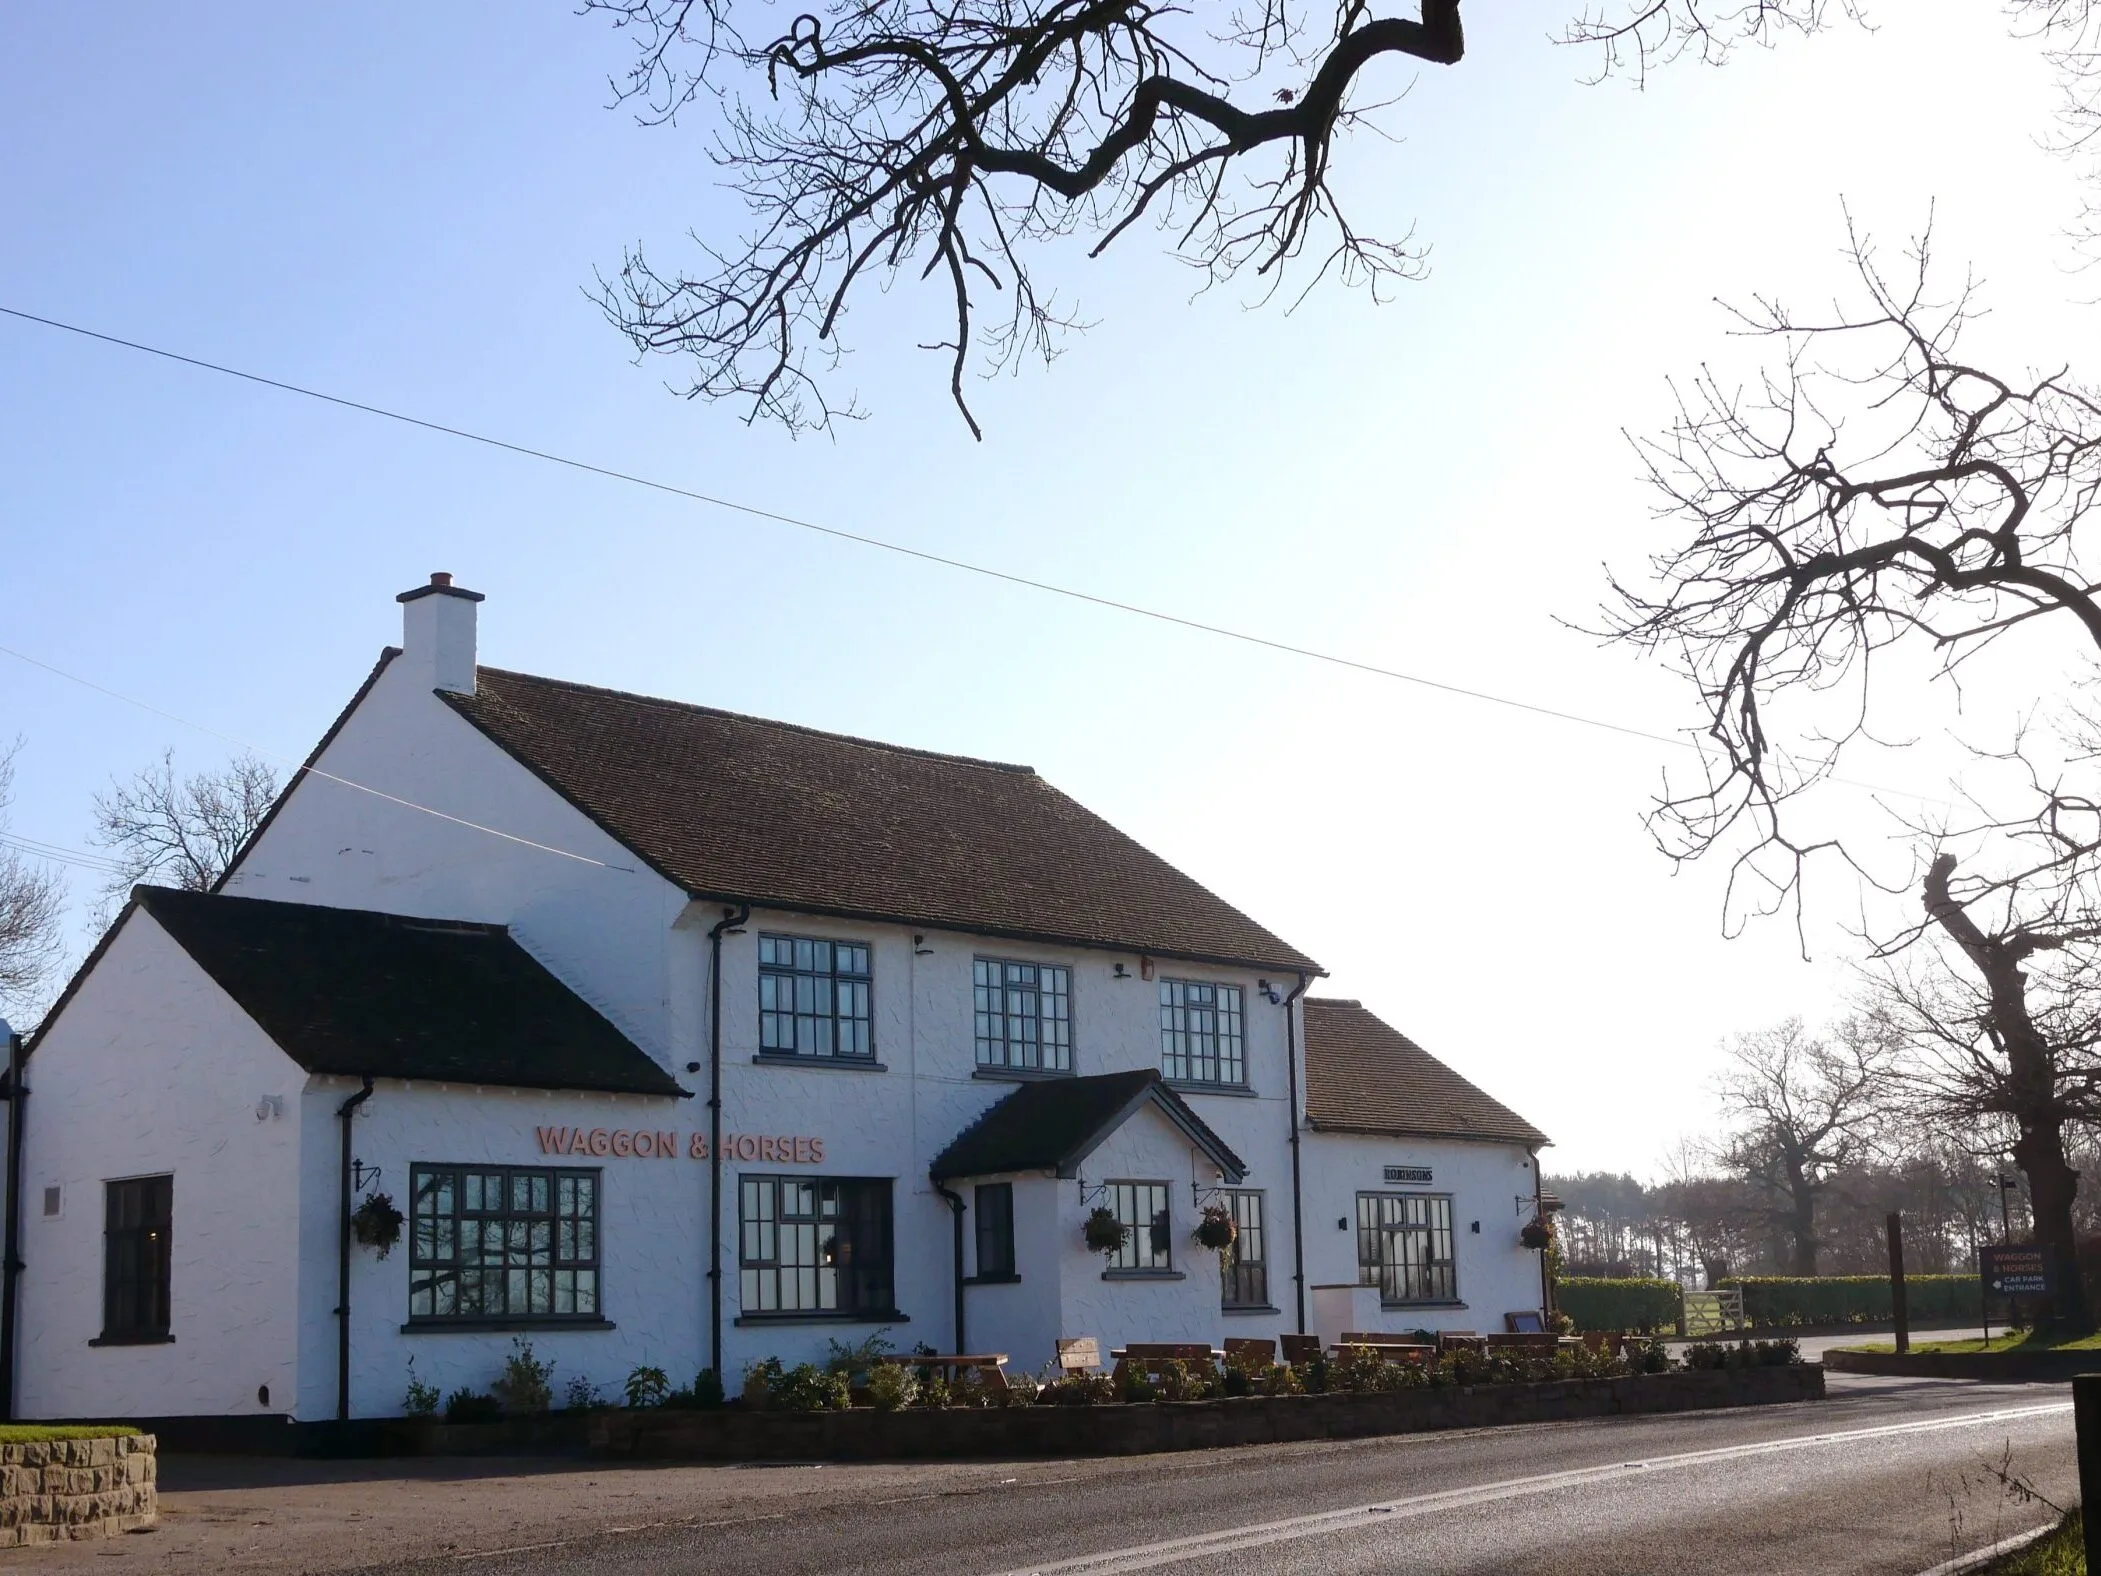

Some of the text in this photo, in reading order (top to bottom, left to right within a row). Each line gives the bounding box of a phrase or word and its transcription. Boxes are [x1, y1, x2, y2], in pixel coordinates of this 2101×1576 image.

[537, 1125, 826, 1163] WAGGON & HORSES
[1993, 1253, 2041, 1261] WAGGON
[2003, 1264, 2043, 1273] HORSES
[2004, 1284, 2046, 1292] ENTRANCE
